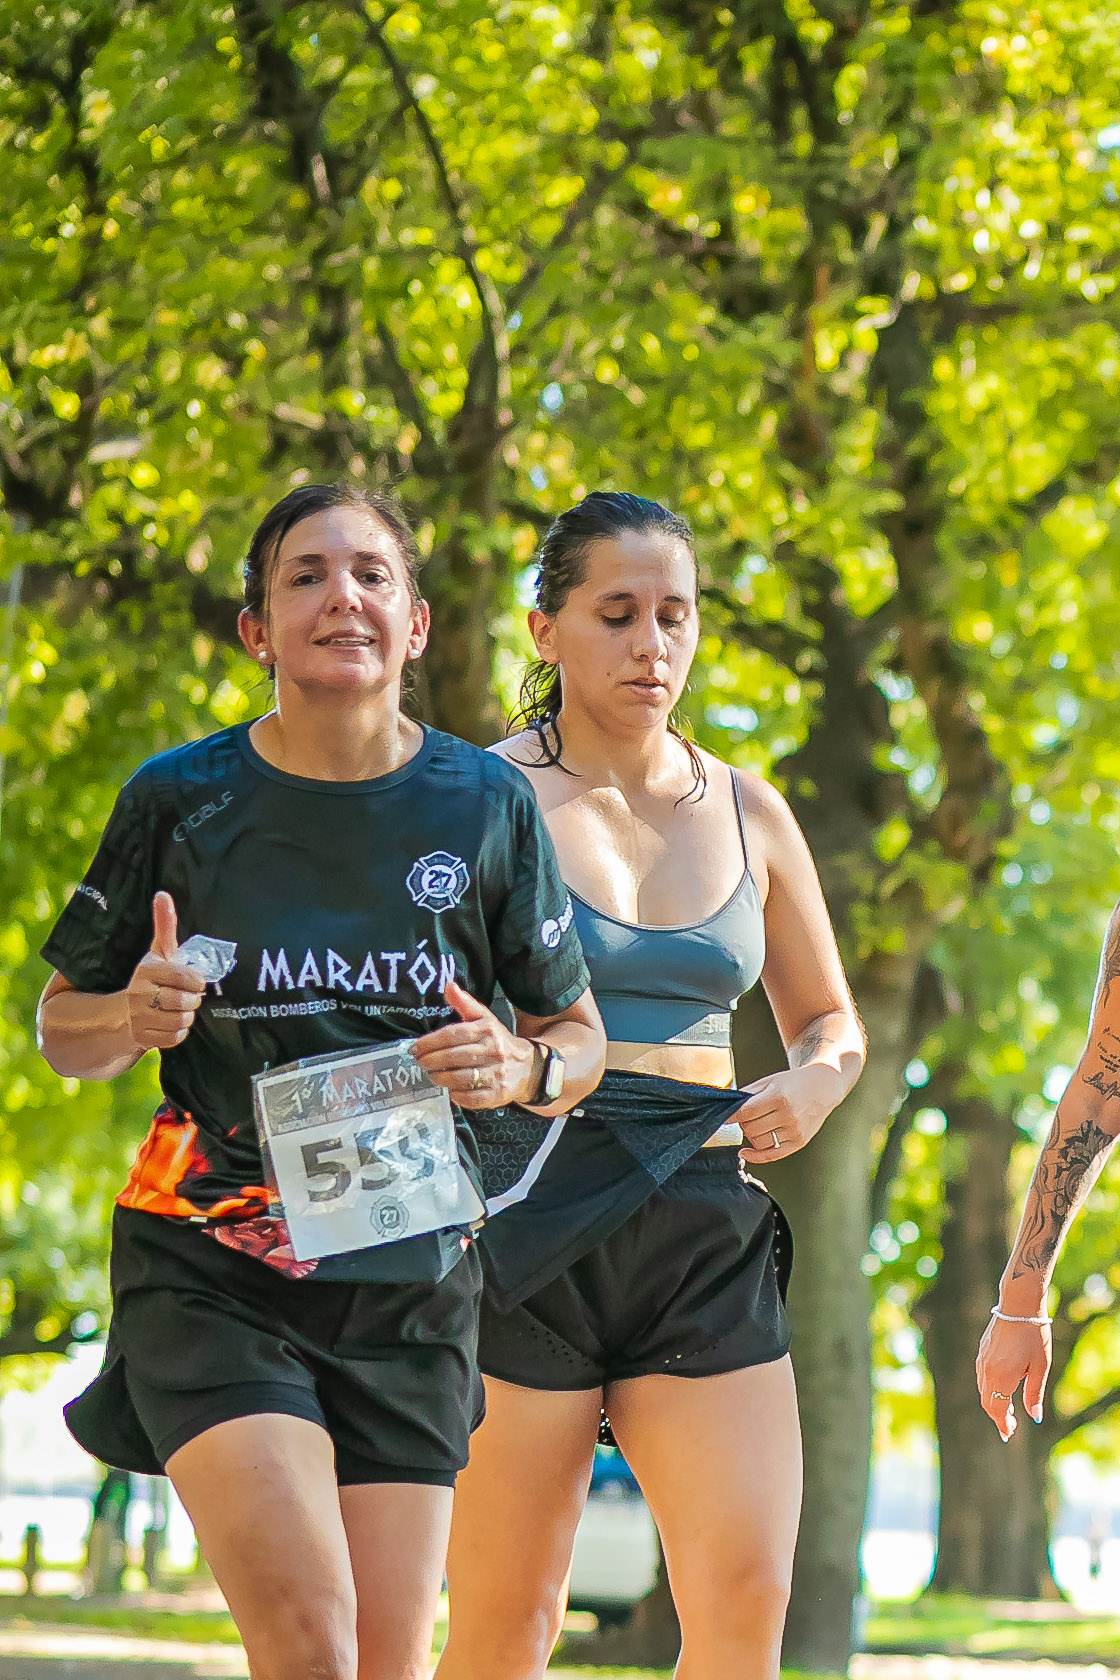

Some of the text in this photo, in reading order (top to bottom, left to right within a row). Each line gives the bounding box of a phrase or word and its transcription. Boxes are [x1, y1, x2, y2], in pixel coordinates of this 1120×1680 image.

[428, 869, 453, 889] 27
[256, 938, 456, 996] MARATÓN
[270, 998, 338, 1017] BOMBEROS
